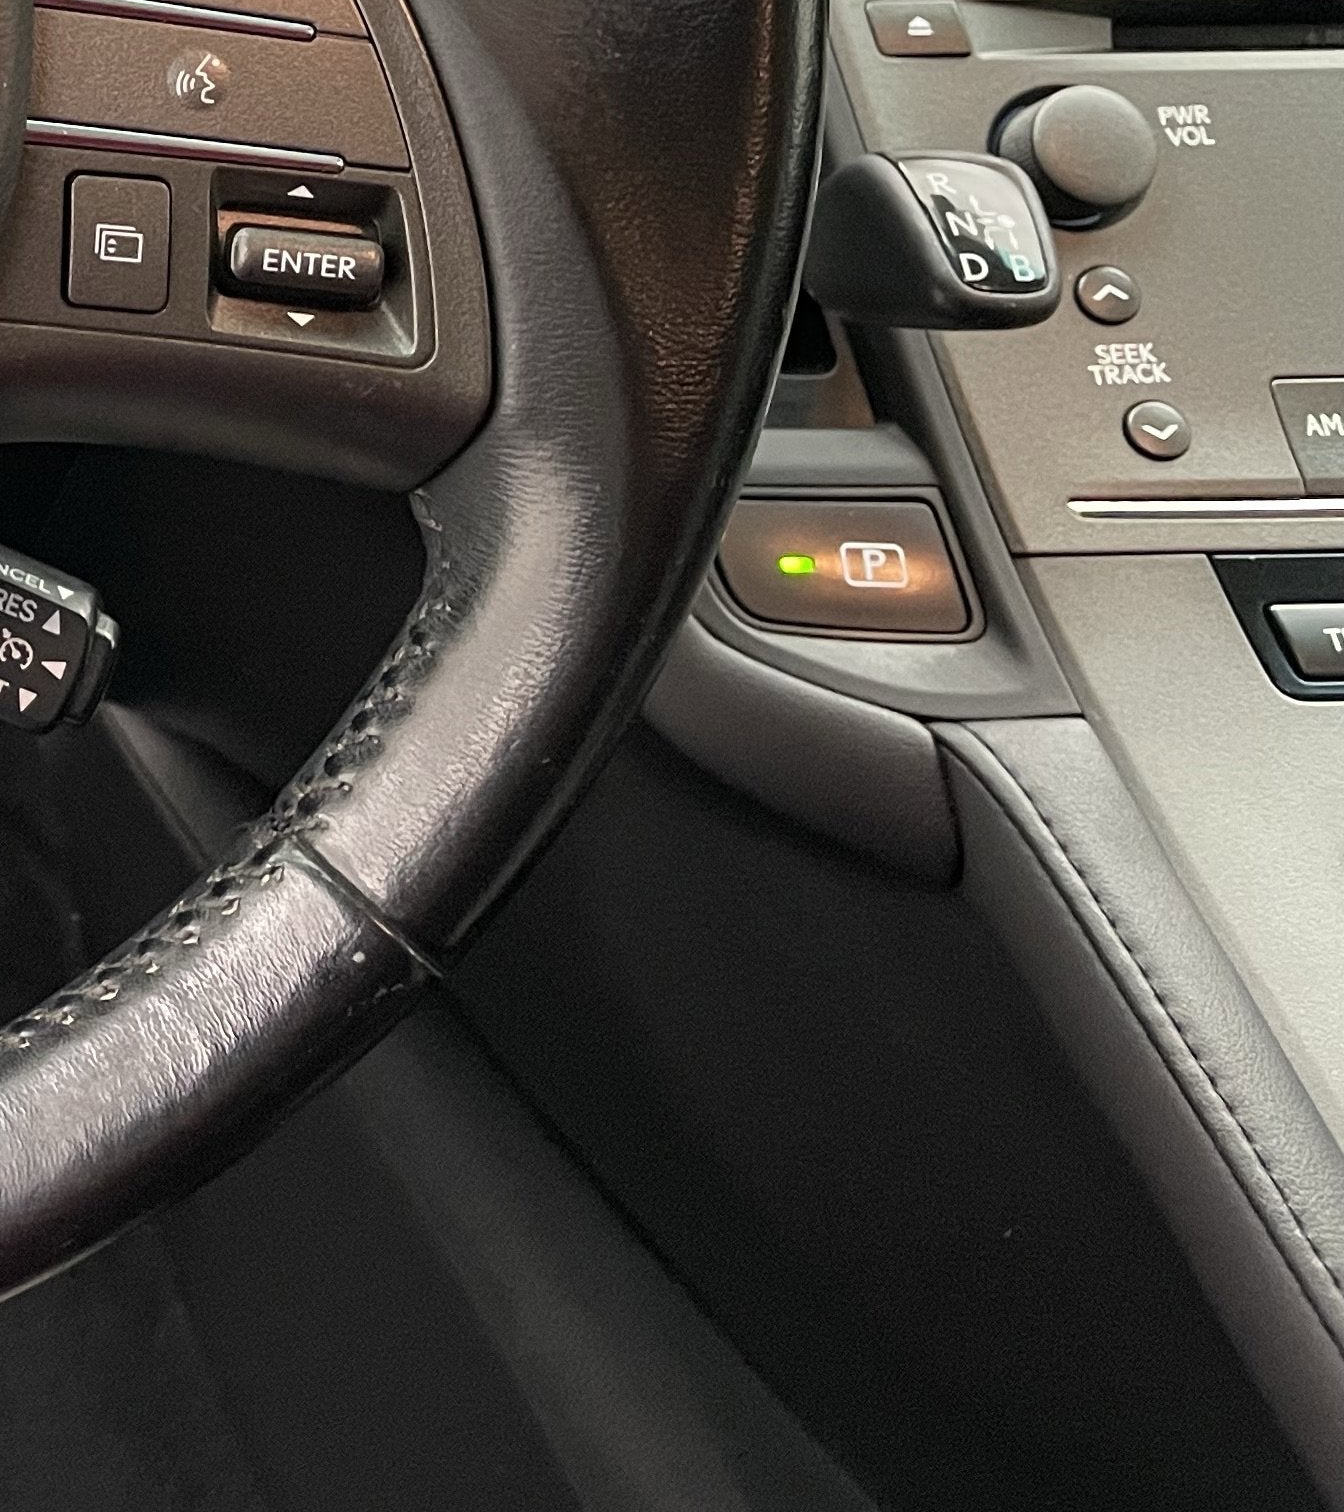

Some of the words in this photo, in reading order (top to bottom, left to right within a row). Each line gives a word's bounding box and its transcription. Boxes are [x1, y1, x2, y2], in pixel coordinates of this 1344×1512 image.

[1156, 104, 1213, 127] PWR
[1163, 123, 1216, 148] VOL
[926, 172, 958, 195] R
[944, 210, 979, 238] N
[261, 247, 357, 281] ENTER
[958, 252, 990, 283] D
[1009, 253, 1036, 283] B
[1093, 342, 1159, 365] SEEK
[1086, 360, 1174, 387] TRACK
